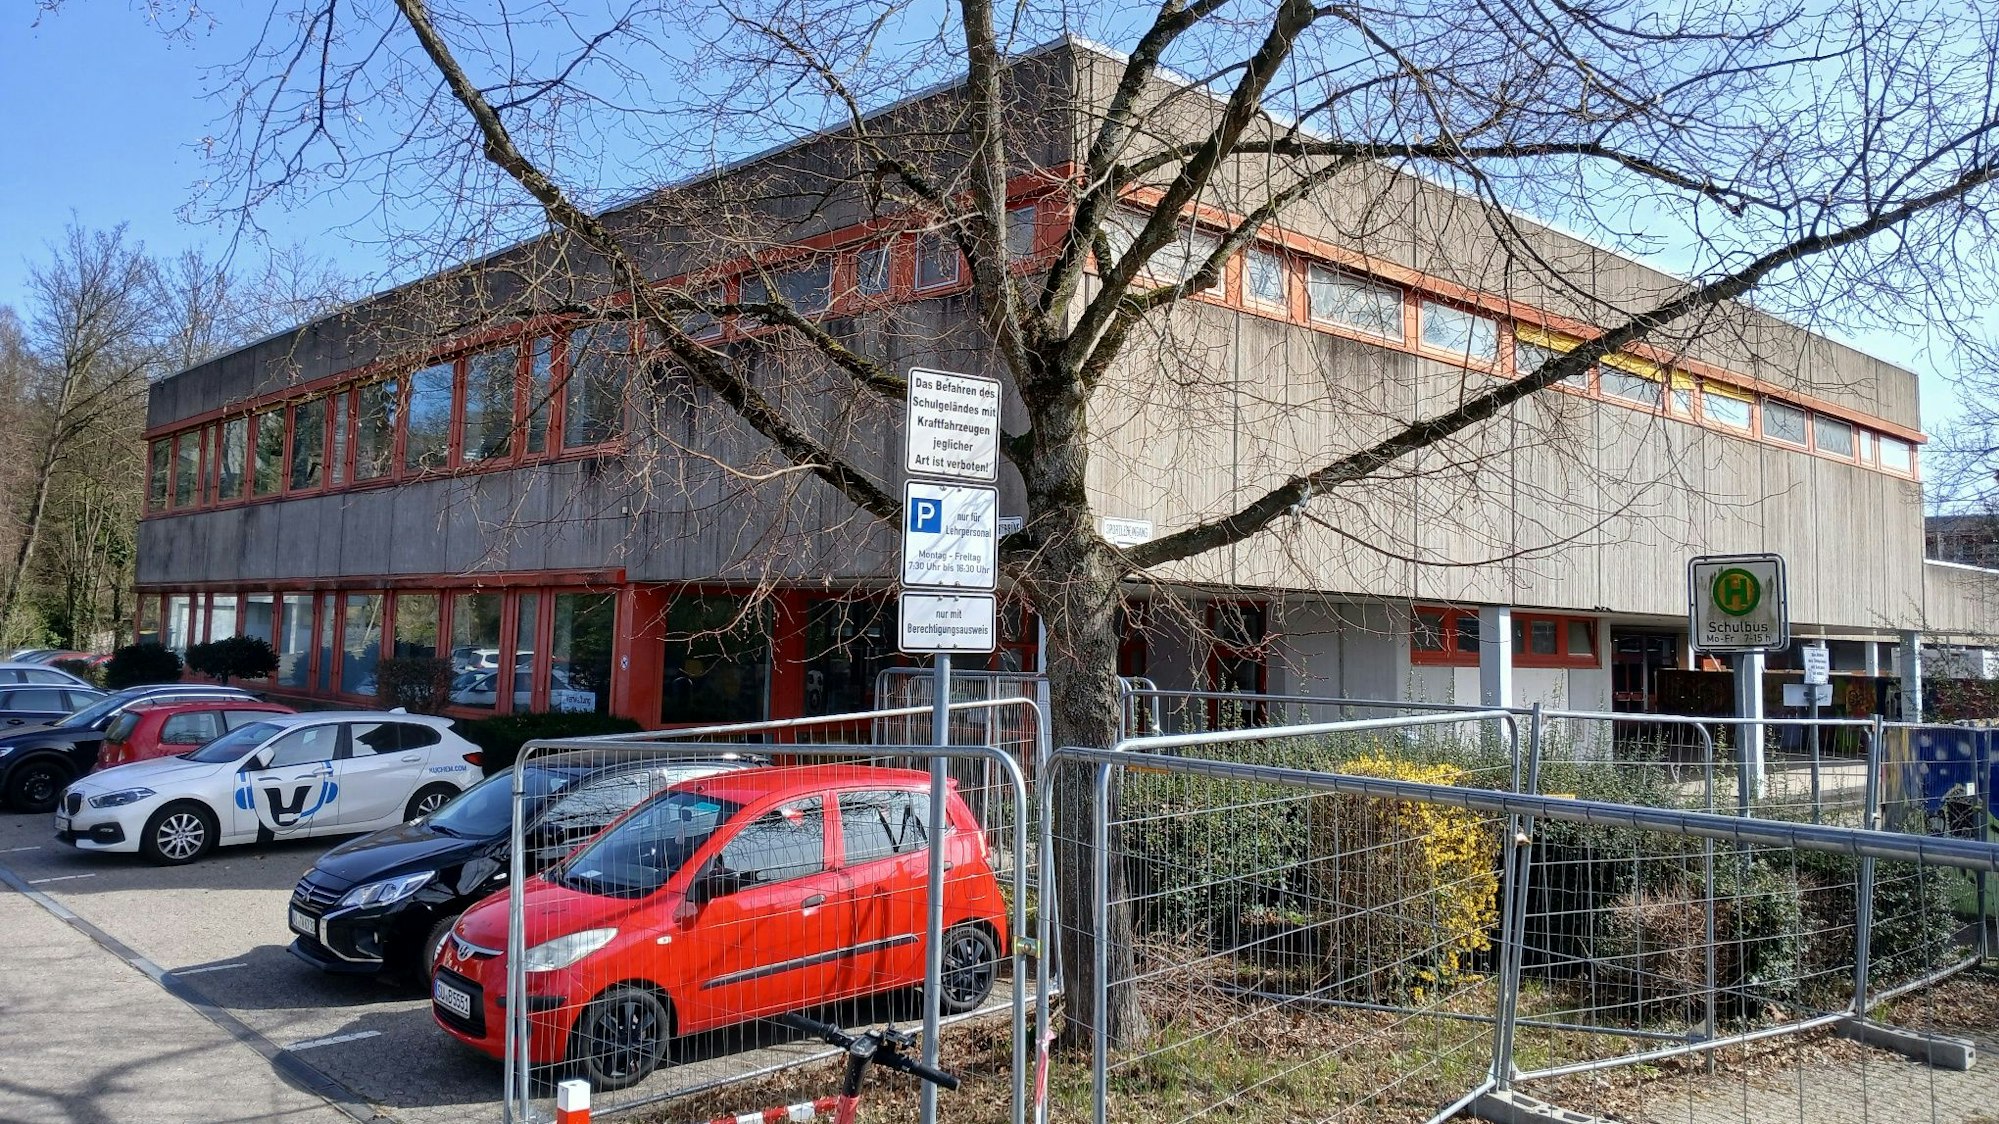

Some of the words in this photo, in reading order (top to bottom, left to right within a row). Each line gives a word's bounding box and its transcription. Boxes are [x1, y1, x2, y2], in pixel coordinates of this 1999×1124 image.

[915, 378, 932, 389] Das
[936, 380, 976, 396] Befahren
[979, 387, 995, 398] des
[913, 396, 978, 415] Schulgeländes
[982, 406, 996, 418] mit
[917, 416, 990, 436] Kraftfahrzeugen
[933, 437, 973, 451] jeglicher
[915, 454, 929, 466] Art
[933, 456, 944, 467] ist
[947, 459, 988, 472] verboten!
[918, 502, 935, 529] P
[957, 513, 969, 521] nur
[970, 512, 981, 522] für
[945, 525, 991, 538] Lehrpersonal
[919, 550, 947, 561] Montag
[955, 552, 981, 562] Freitag
[909, 561, 924, 570] 7:30
[926, 562, 940, 571] Uhr
[943, 563, 954, 572] bis
[976, 565, 990, 574] Uhr
[1725, 579, 1748, 605] H
[936, 610, 948, 619] nur
[950, 608, 962, 619] mit
[907, 622, 988, 636] Berechtigungsausweis
[1709, 621, 1768, 633] Schulbus
[1707, 634, 1735, 642] Mo-Fr
[1744, 634, 1762, 642] 7-15
[1766, 634, 1771, 642] h
